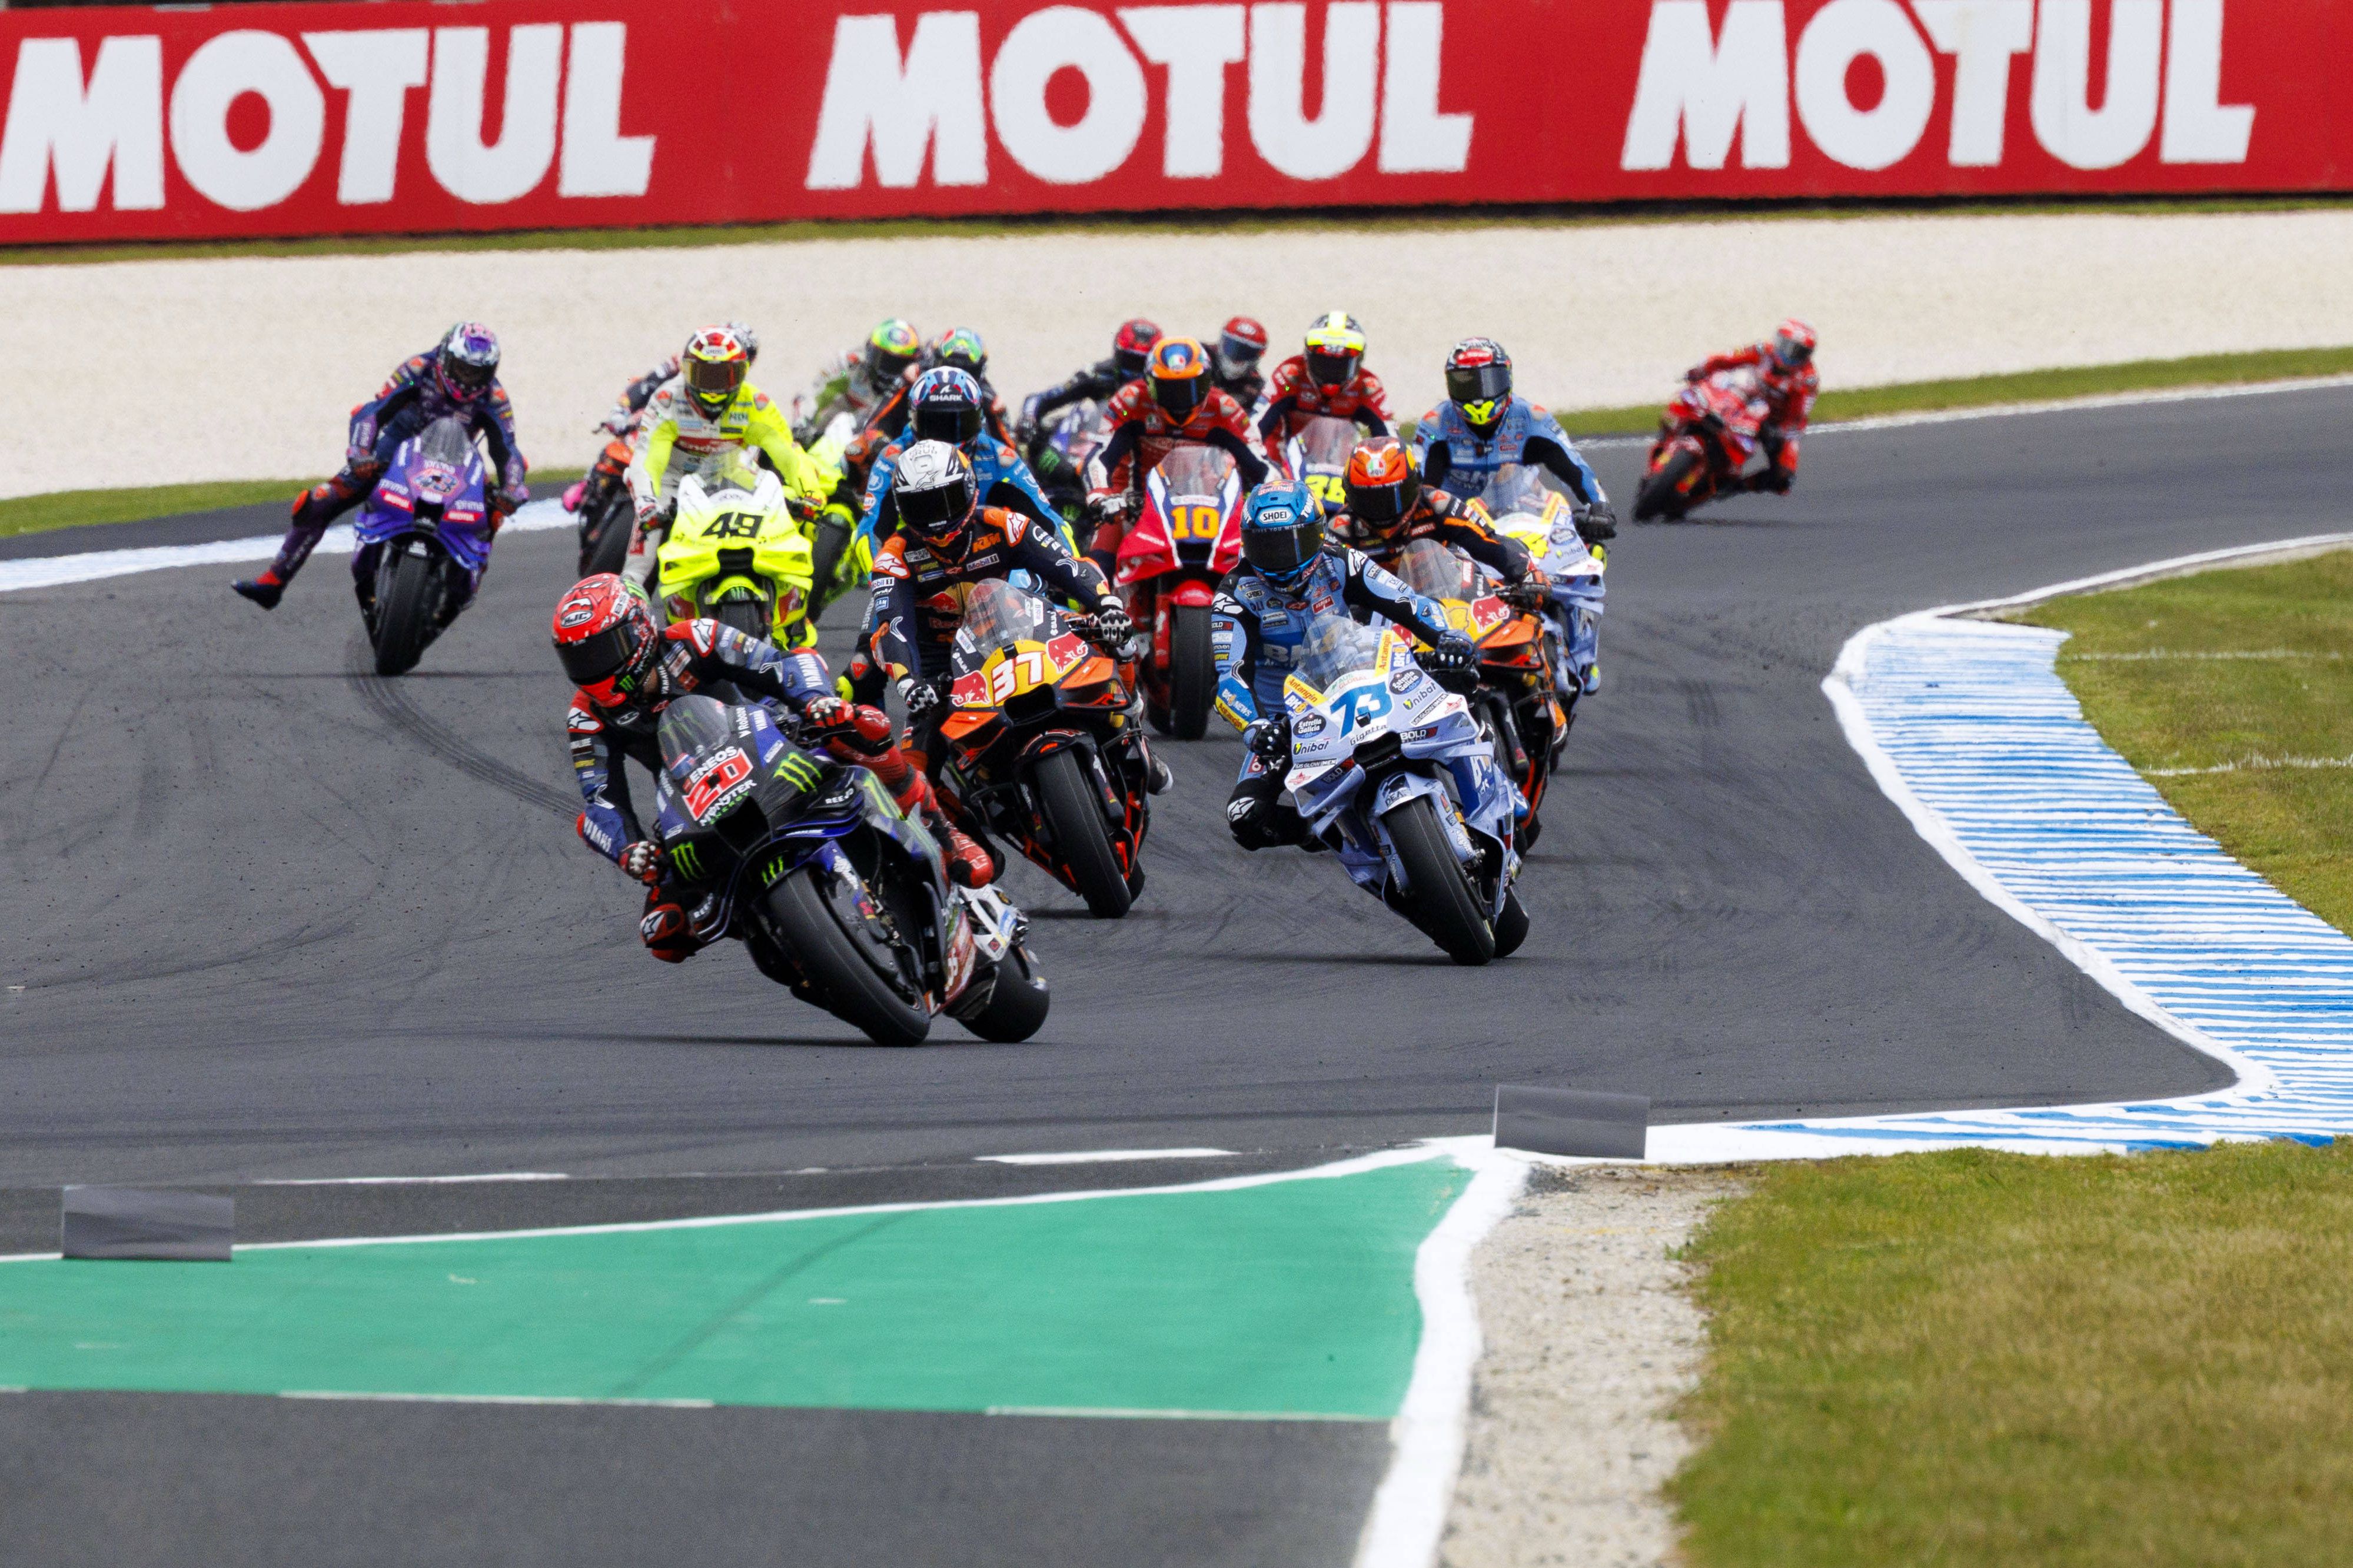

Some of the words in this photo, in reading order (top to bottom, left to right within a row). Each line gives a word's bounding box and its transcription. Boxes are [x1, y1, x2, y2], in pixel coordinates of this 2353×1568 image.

[804, 1, 1475, 189] MOTUL
[1620, 0, 2255, 171] MOTUL
[0, 21, 657, 214] MOTUL
[701, 511, 764, 539] 49
[1171, 505, 1220, 540] 10
[1263, 511, 1287, 521] SHOEI
[969, 558, 991, 570] Mobil
[563, 612, 588, 624] HJC
[1378, 634, 1391, 669] Antangin
[992, 651, 1046, 706] 37
[1289, 678, 1318, 703] Antangin
[1392, 671, 1416, 688] Estrella
[1398, 675, 1420, 691] Galicia
[1403, 681, 1437, 710] Unibat
[1234, 701, 1252, 717] NEWS
[1330, 681, 1393, 741] 73
[1298, 718, 1322, 728] Estrella
[1298, 725, 1320, 734] Galicia
[1400, 729, 1427, 741] BOLD
[1294, 740, 1329, 755] Unibat
[689, 745, 737, 784] ENEOS
[1324, 767, 1343, 782] BOLD
[699, 779, 757, 827] MONSTER
